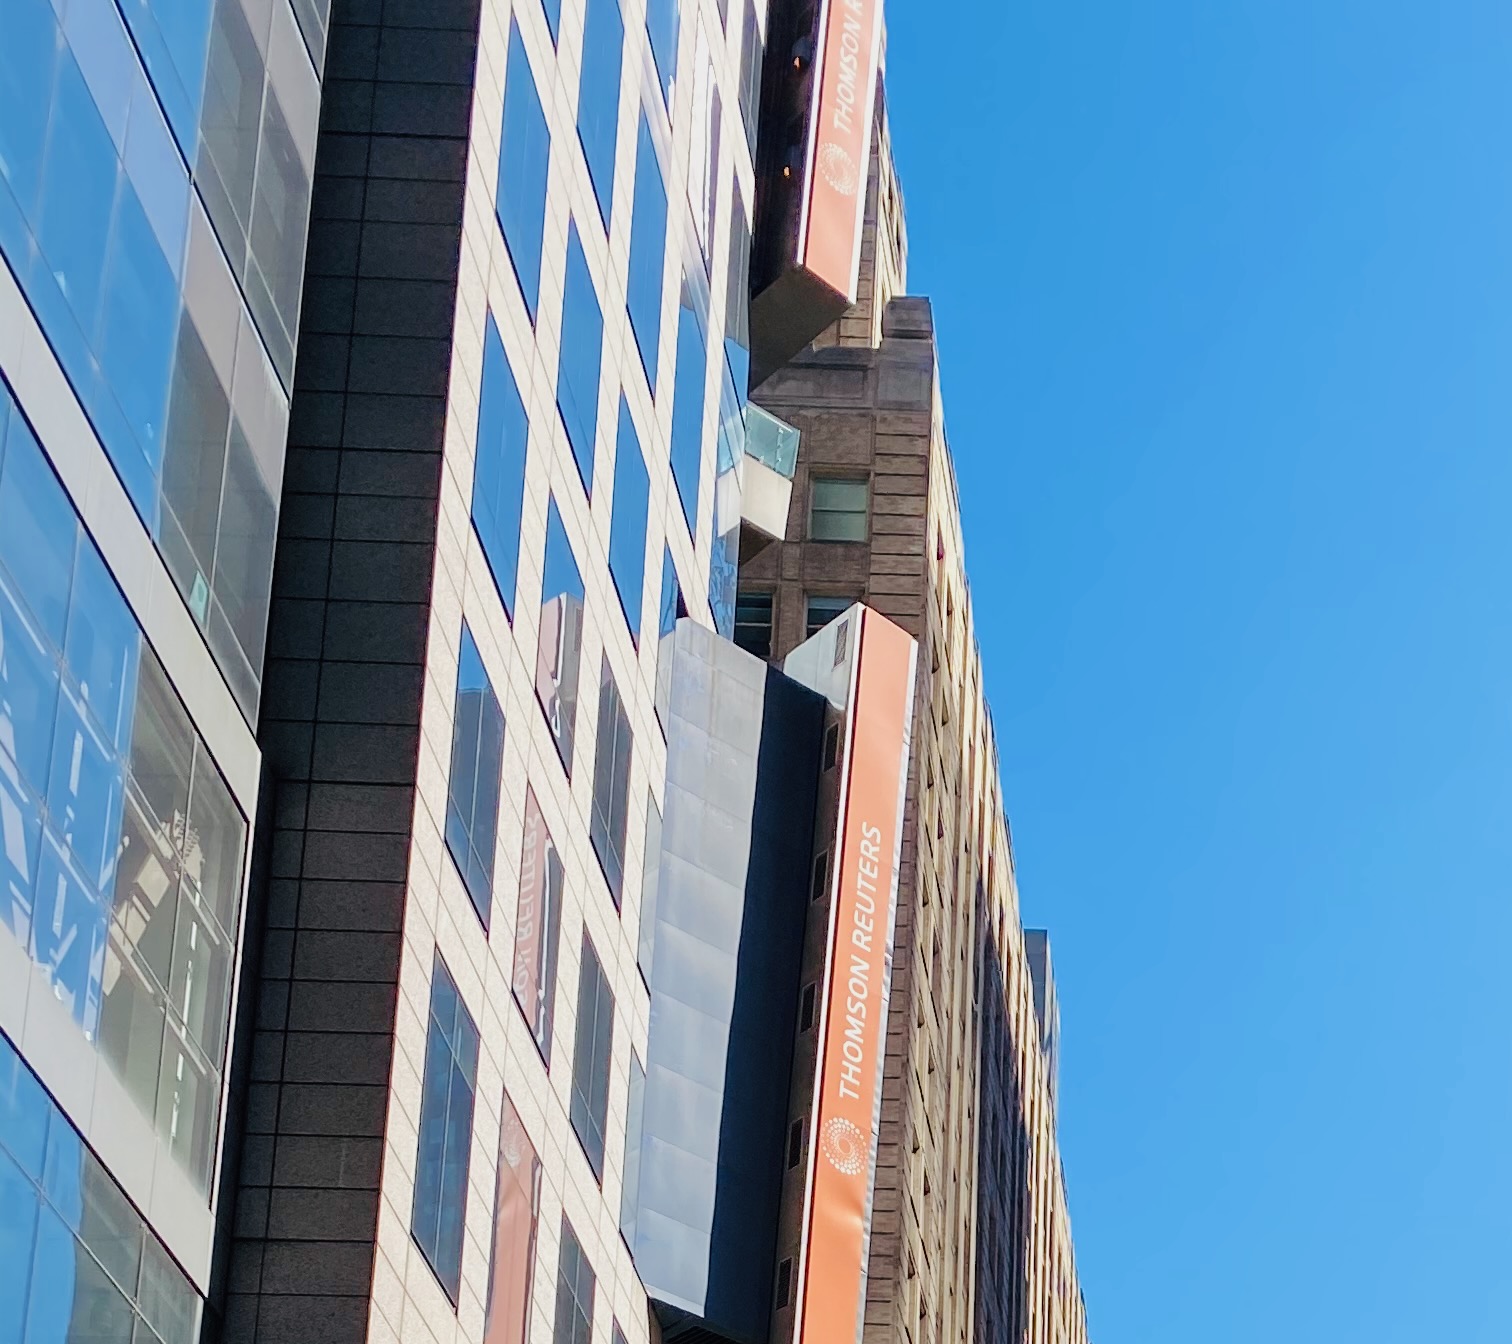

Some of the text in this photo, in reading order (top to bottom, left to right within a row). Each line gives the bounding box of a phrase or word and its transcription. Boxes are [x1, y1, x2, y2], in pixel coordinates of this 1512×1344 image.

[833, 21, 865, 135] THOMSON
[837, 821, 882, 1101] THOMSON REUTERS
